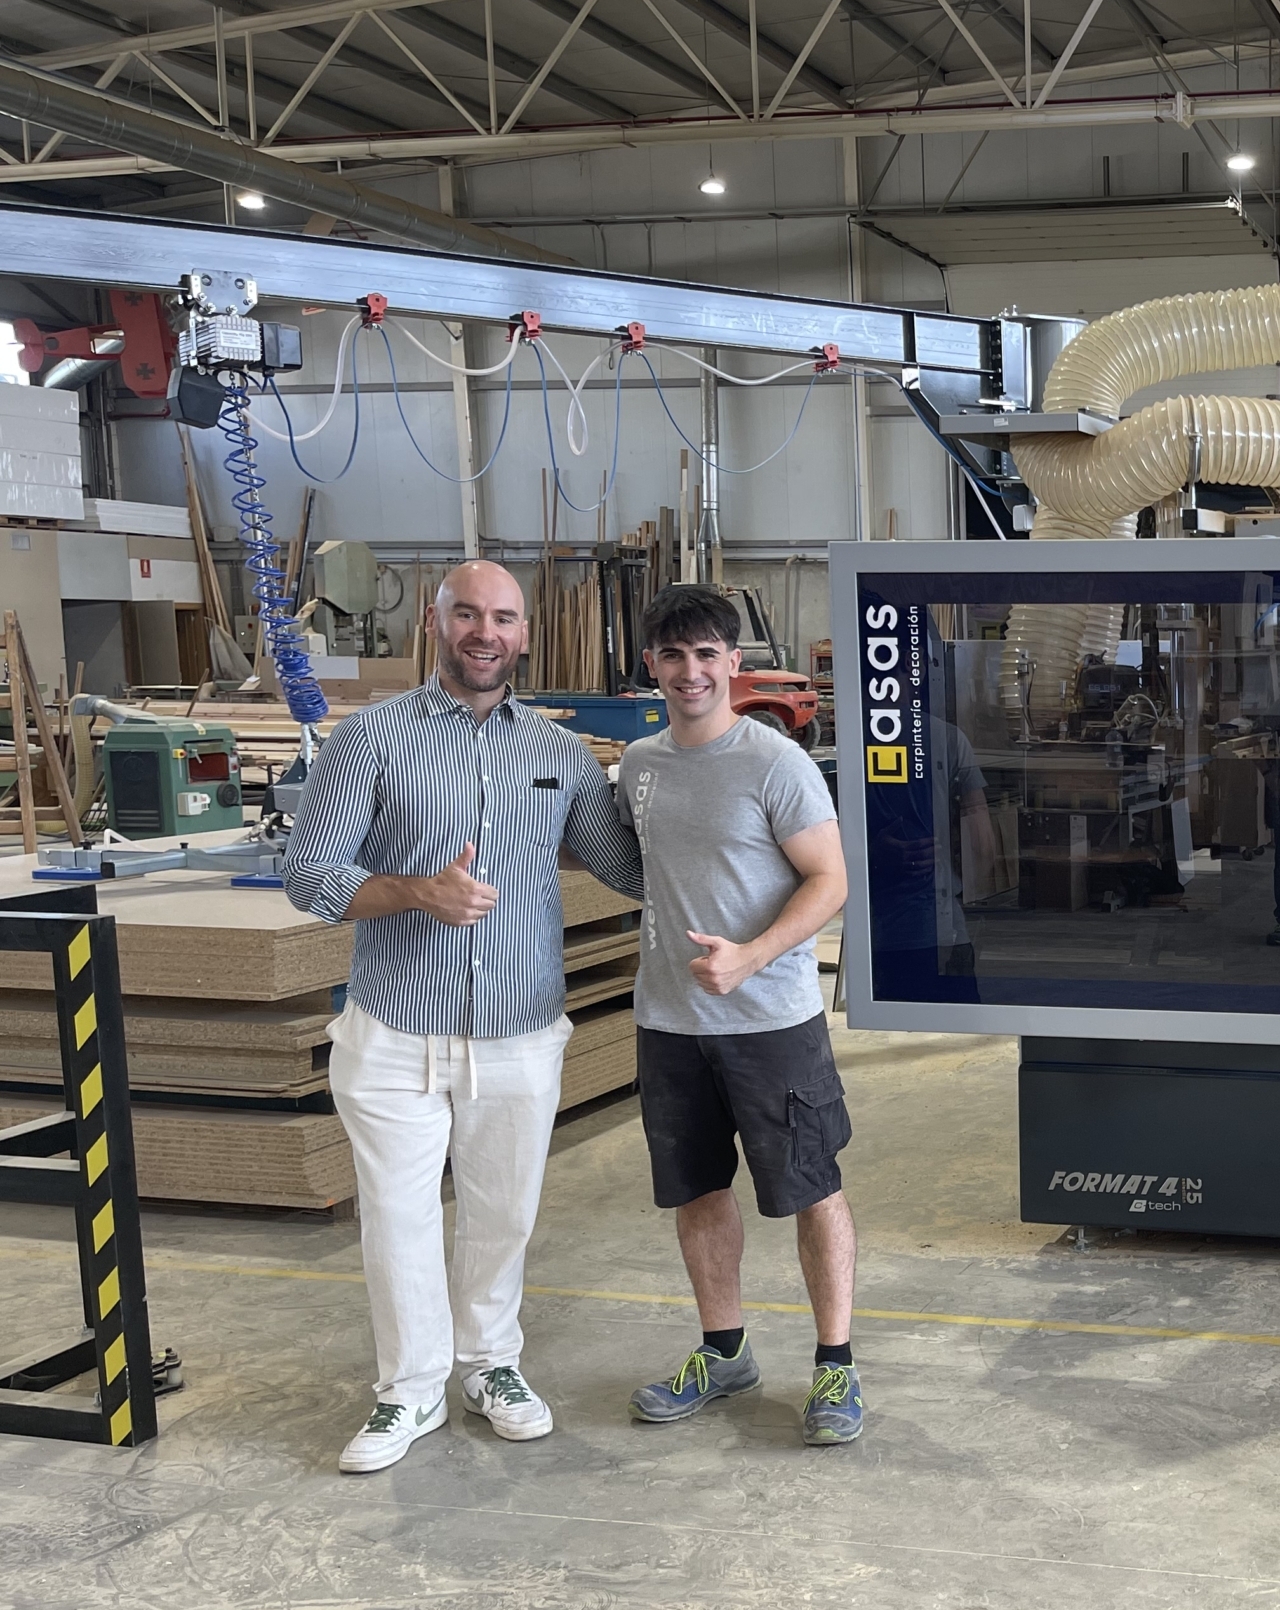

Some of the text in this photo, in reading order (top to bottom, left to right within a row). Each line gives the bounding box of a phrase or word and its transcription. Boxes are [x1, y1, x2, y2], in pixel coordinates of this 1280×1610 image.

[907, 605, 924, 779] carpintería decoración
[1048, 1171, 1158, 1195] FORMAT
[1158, 1177, 1179, 1196] 4
[1186, 1177, 1203, 1204] 25
